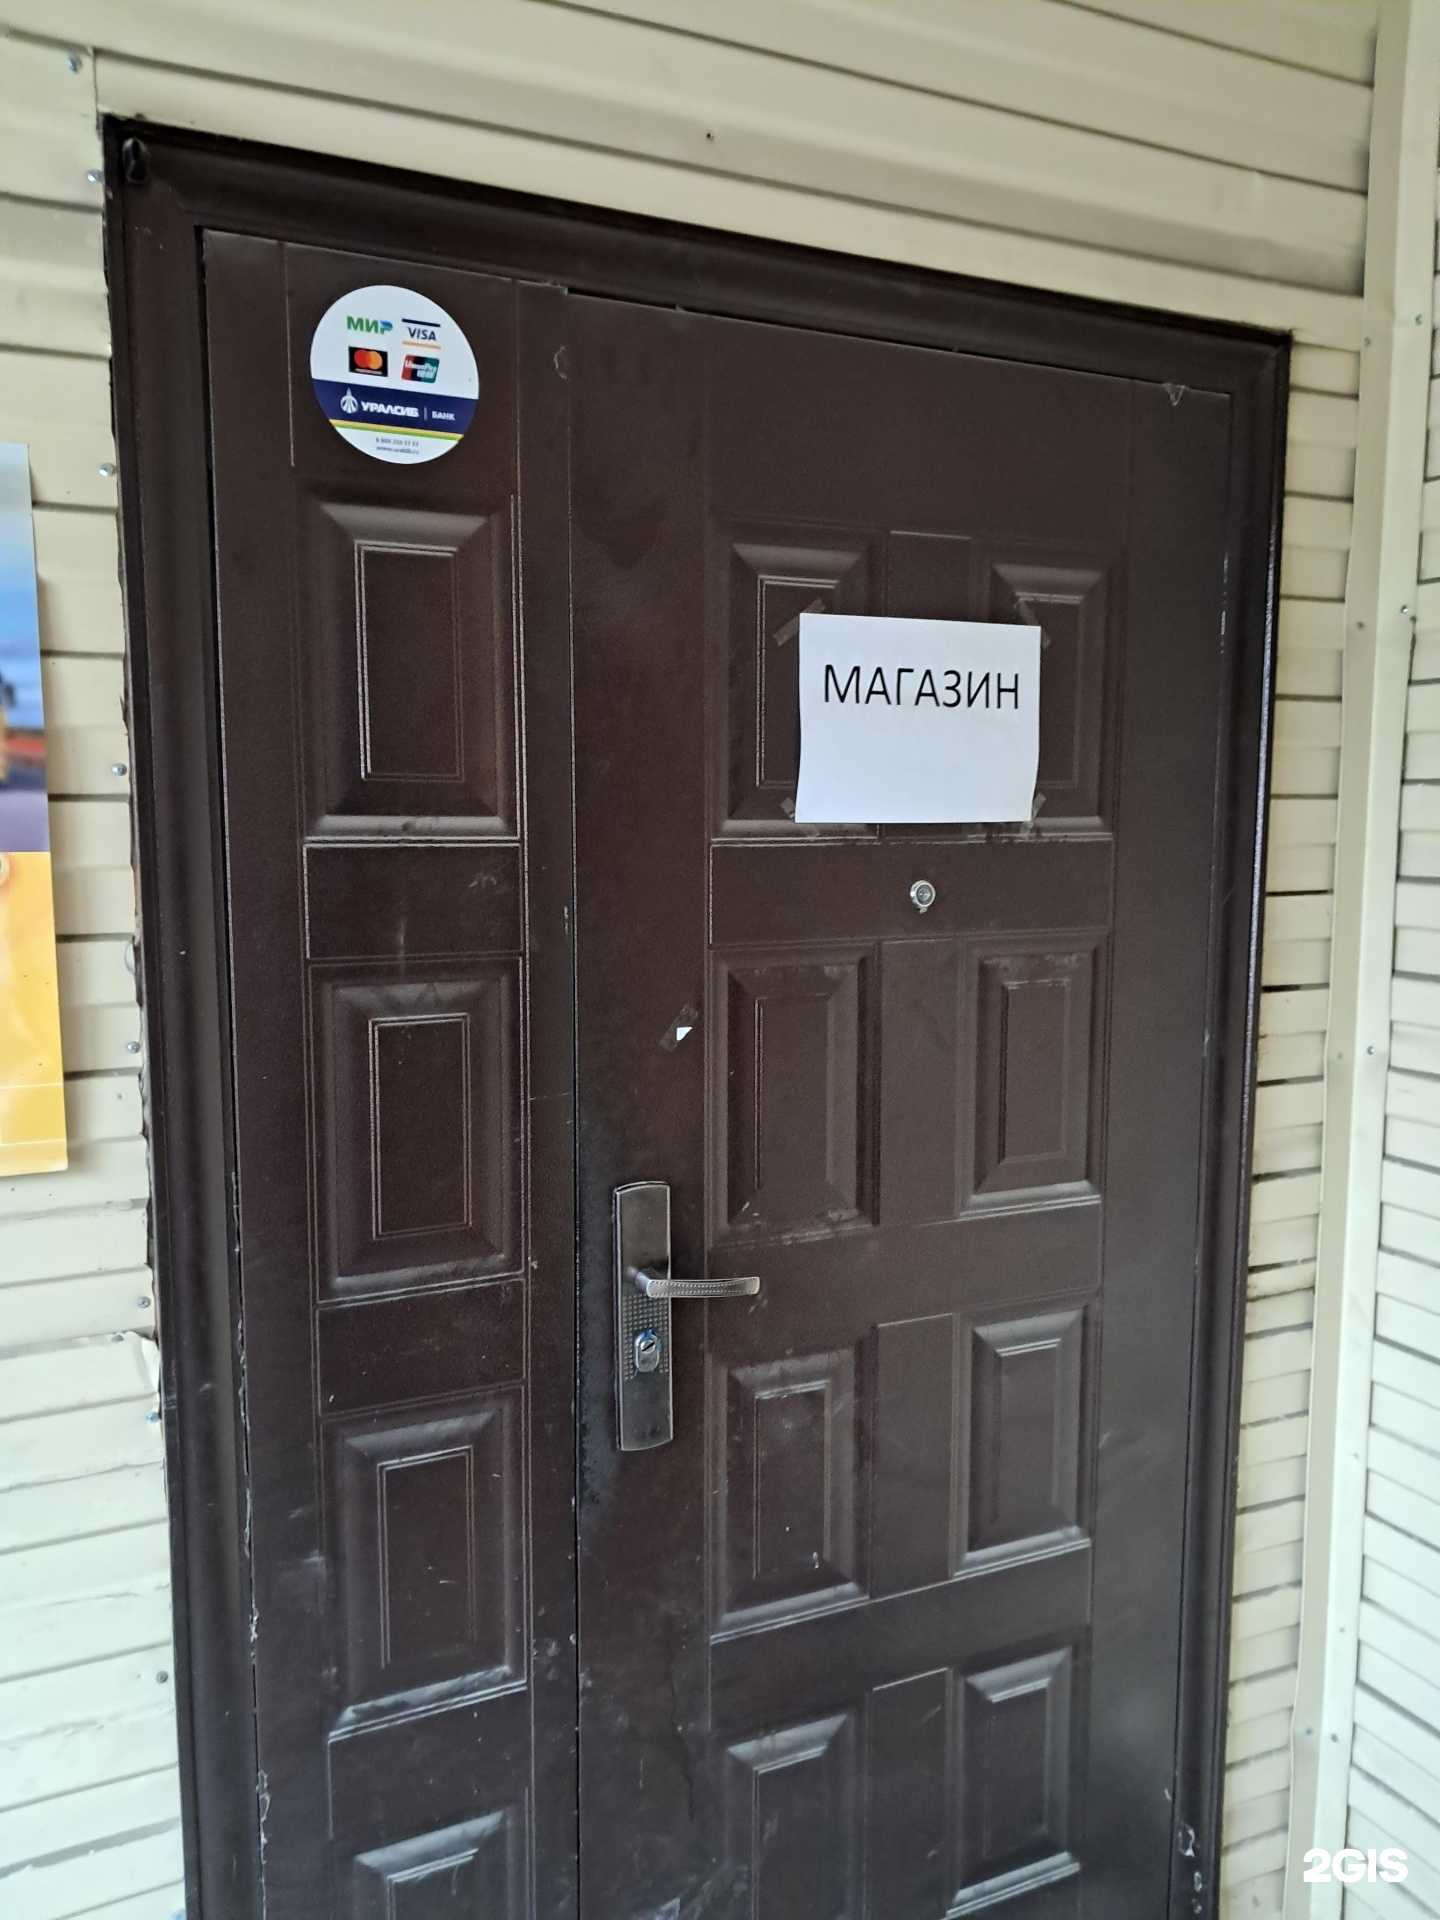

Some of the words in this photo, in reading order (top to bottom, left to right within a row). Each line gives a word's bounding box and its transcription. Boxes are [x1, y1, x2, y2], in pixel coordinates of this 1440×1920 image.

[346, 315, 393, 335] МИР
[408, 326, 437, 341] VISA
[360, 400, 419, 418] УРАЛСИБ
[431, 410, 456, 421] БАНК
[823, 663, 1019, 710] МАГАЗИН
